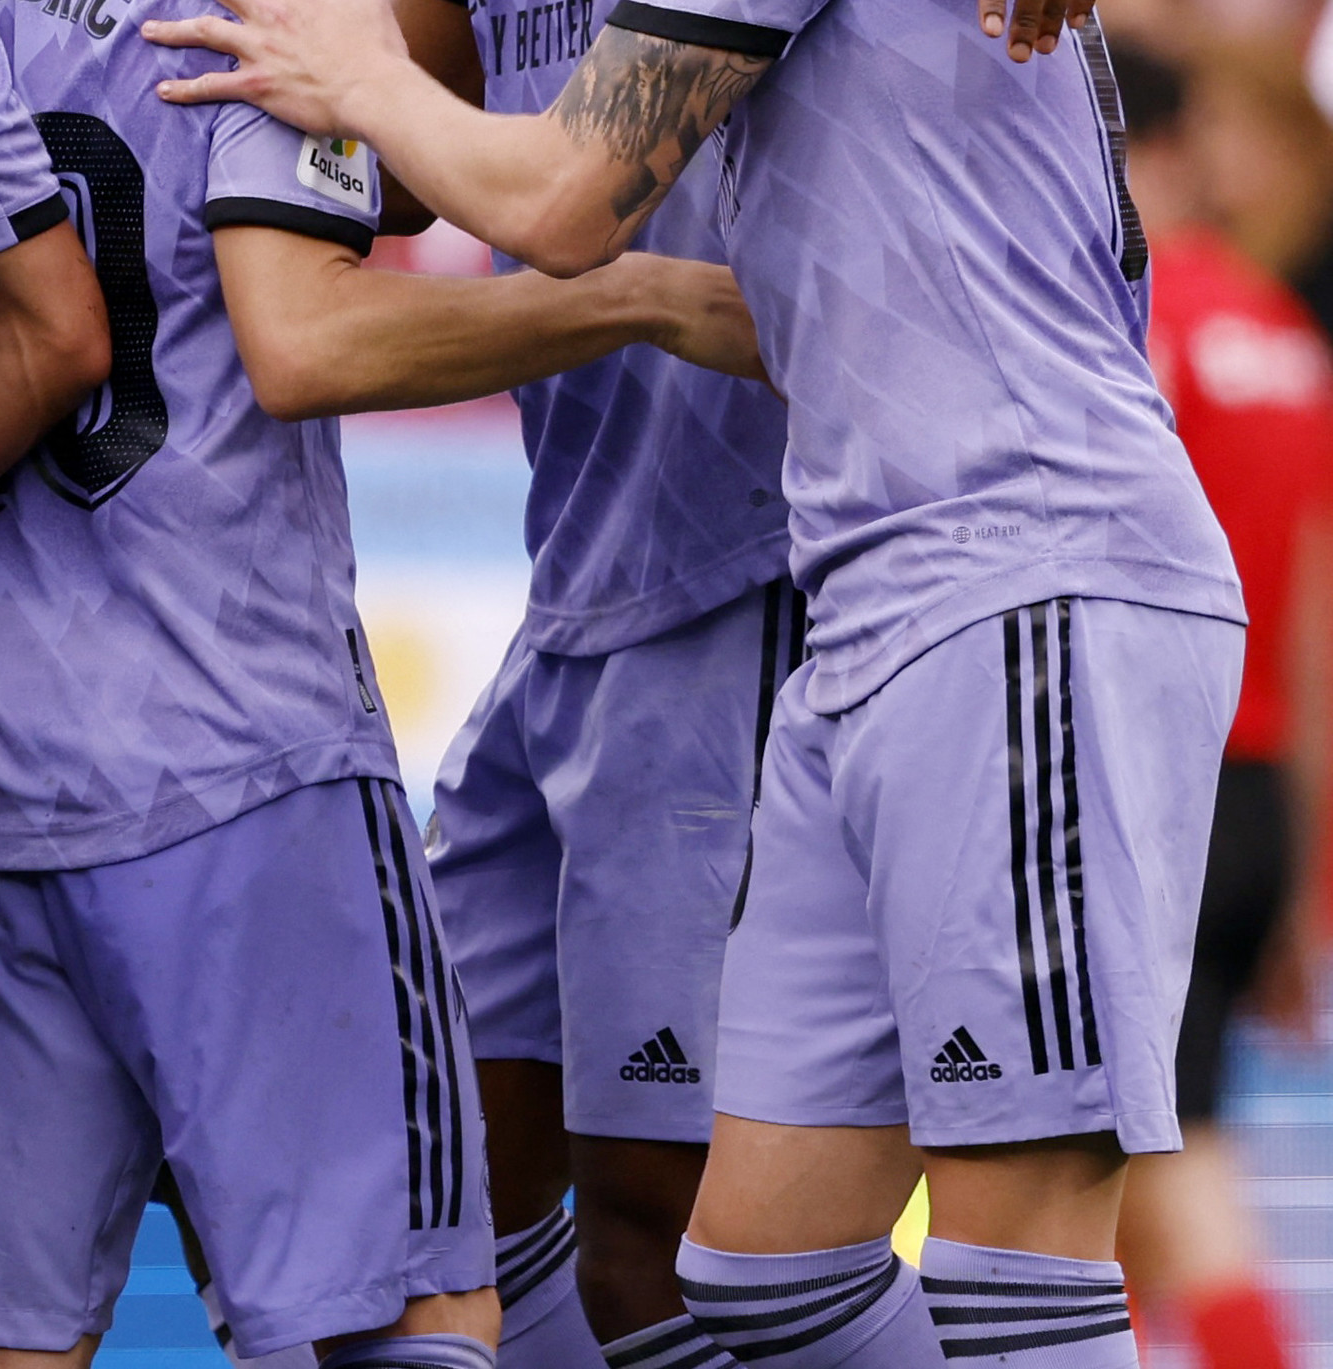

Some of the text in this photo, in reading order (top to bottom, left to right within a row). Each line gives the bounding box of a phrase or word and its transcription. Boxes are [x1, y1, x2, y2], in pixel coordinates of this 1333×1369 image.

[309, 148, 364, 194] LaLiga
[619, 1063, 701, 1084] adidas
[930, 1061, 1003, 1083] adidas
